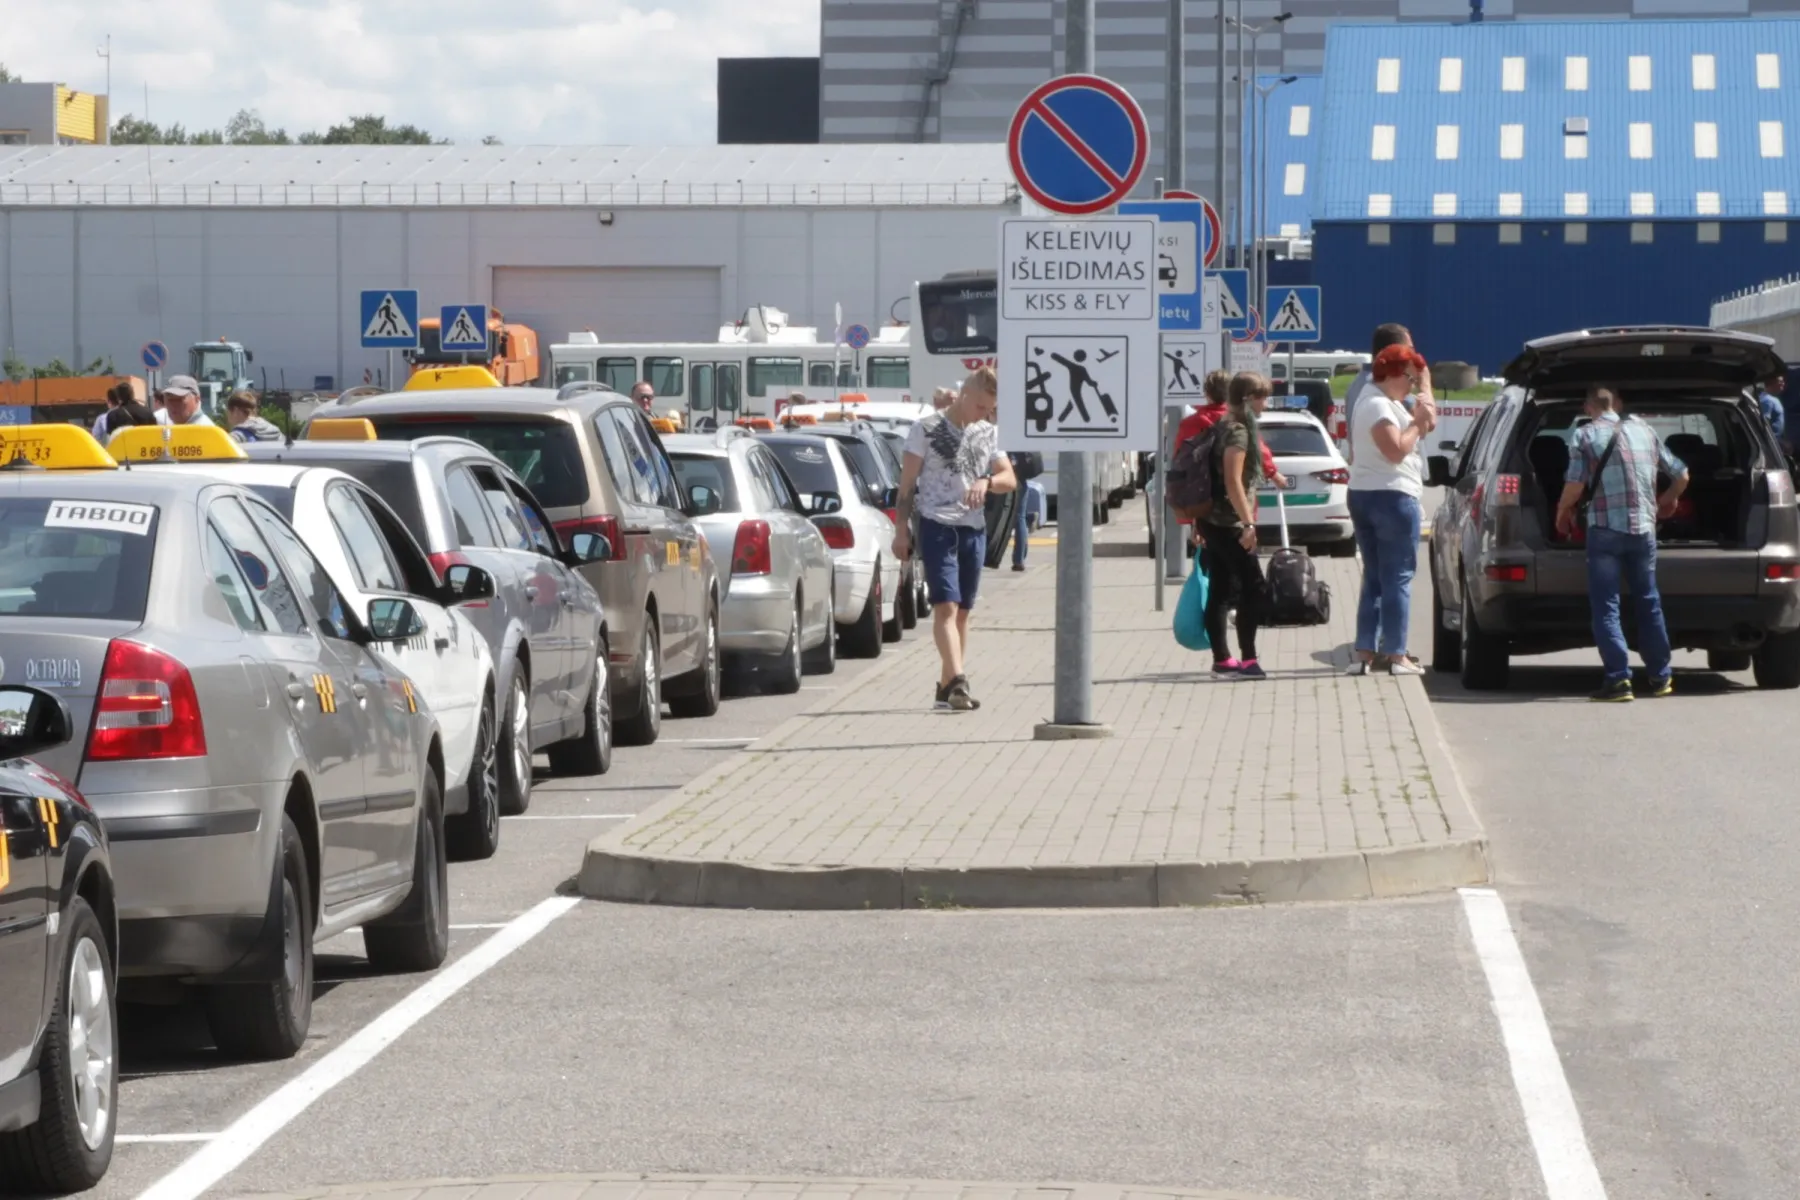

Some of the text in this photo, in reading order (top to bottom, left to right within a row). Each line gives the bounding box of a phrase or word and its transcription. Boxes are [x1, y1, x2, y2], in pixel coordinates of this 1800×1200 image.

[1025, 230, 1132, 255] KELEIVIŲ
[1011, 256, 1146, 280] IŠLEIDIMAS
[1026, 293, 1131, 310] KISS & FLY
[1159, 306, 1191, 322] ietų
[172, 445, 203, 457] 18096
[54, 505, 148, 526] TABOO
[26, 658, 80, 680] OCTAVIA
